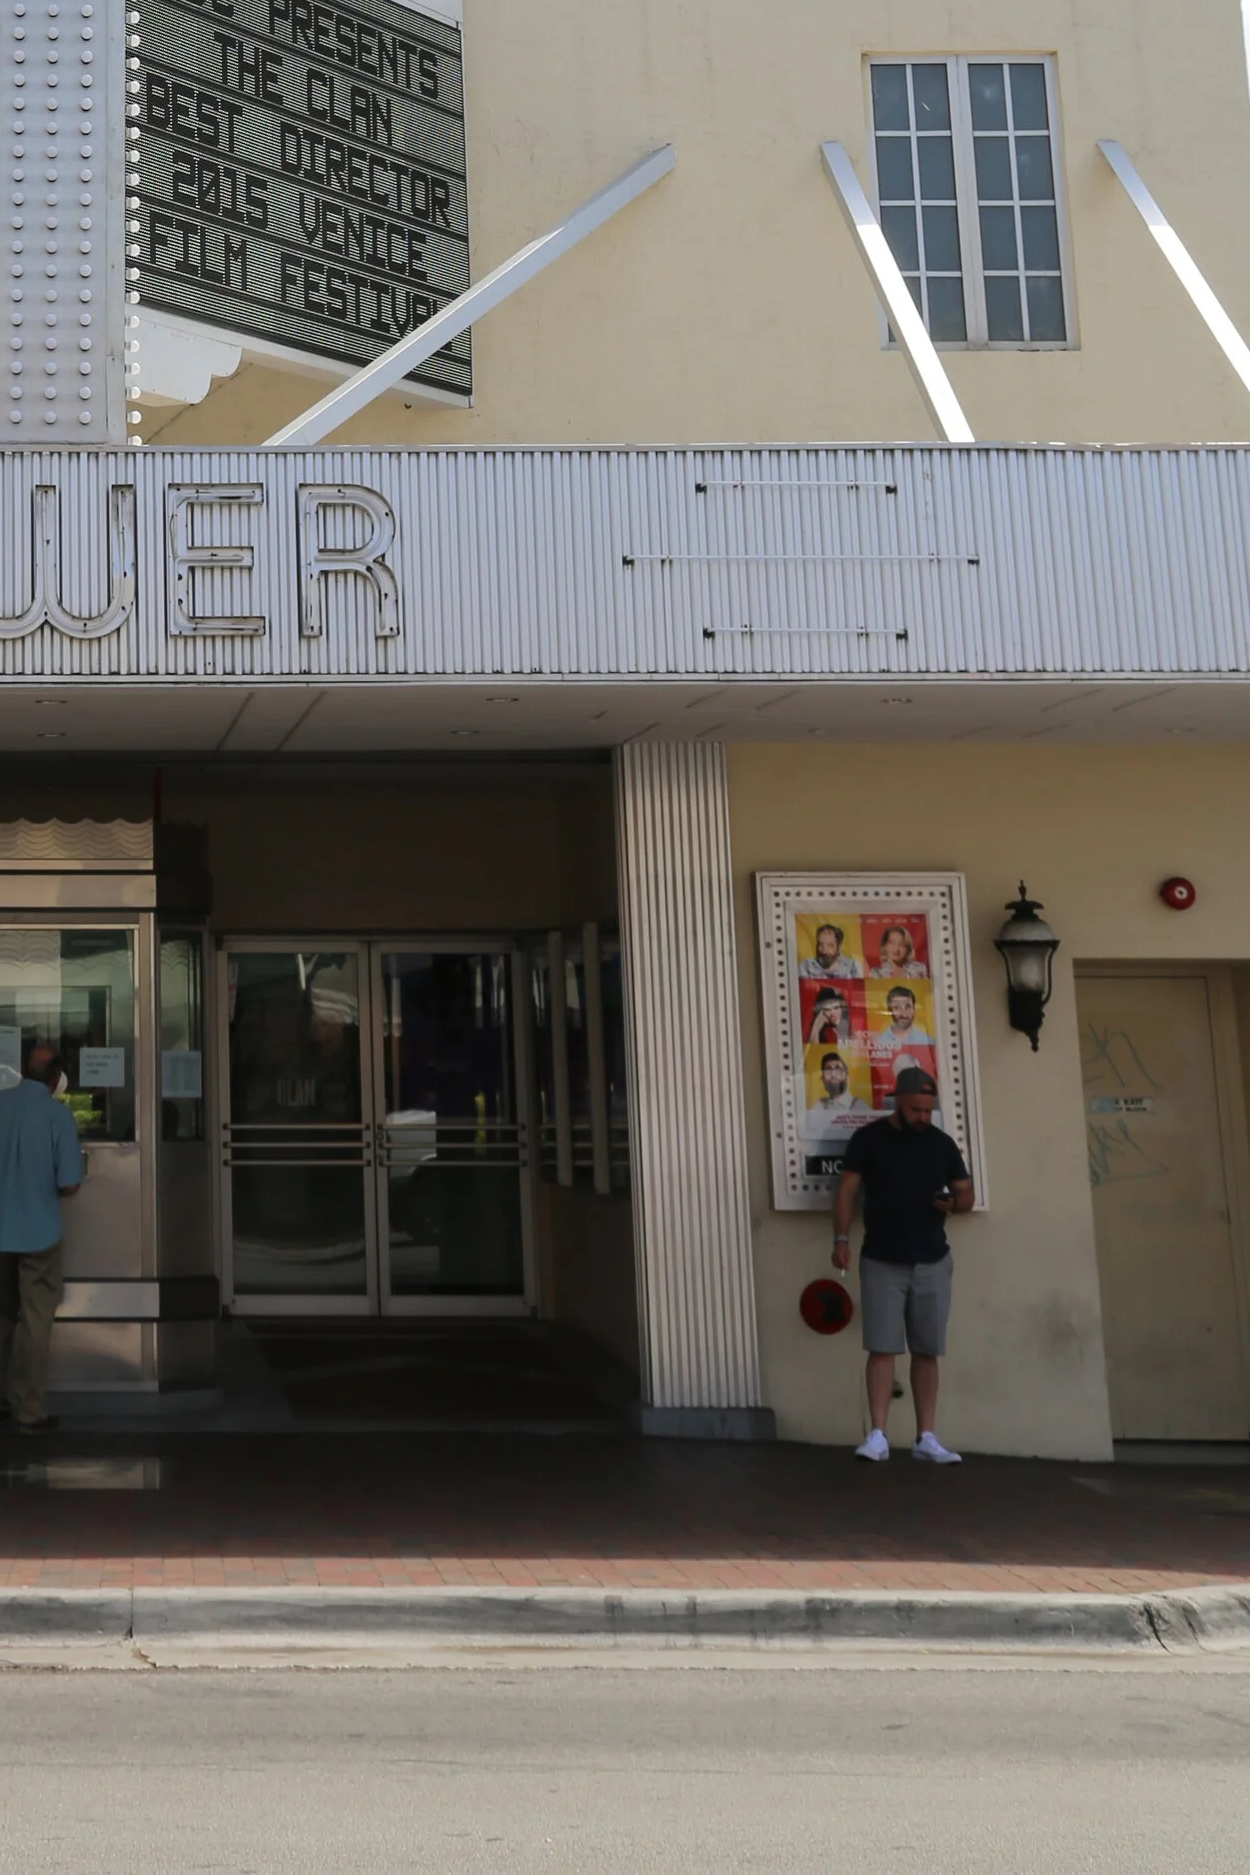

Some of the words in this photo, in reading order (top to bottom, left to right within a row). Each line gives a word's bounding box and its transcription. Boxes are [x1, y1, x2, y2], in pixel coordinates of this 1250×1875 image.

[214, 31, 285, 105] THE
[306, 67, 392, 145] CLAN
[147, 75, 244, 155] BEST
[280, 125, 450, 230] DIRECTOR
[151, 215, 248, 292] FILM
[171, 149, 268, 232] 2015
[299, 191, 428, 282] VENICE
